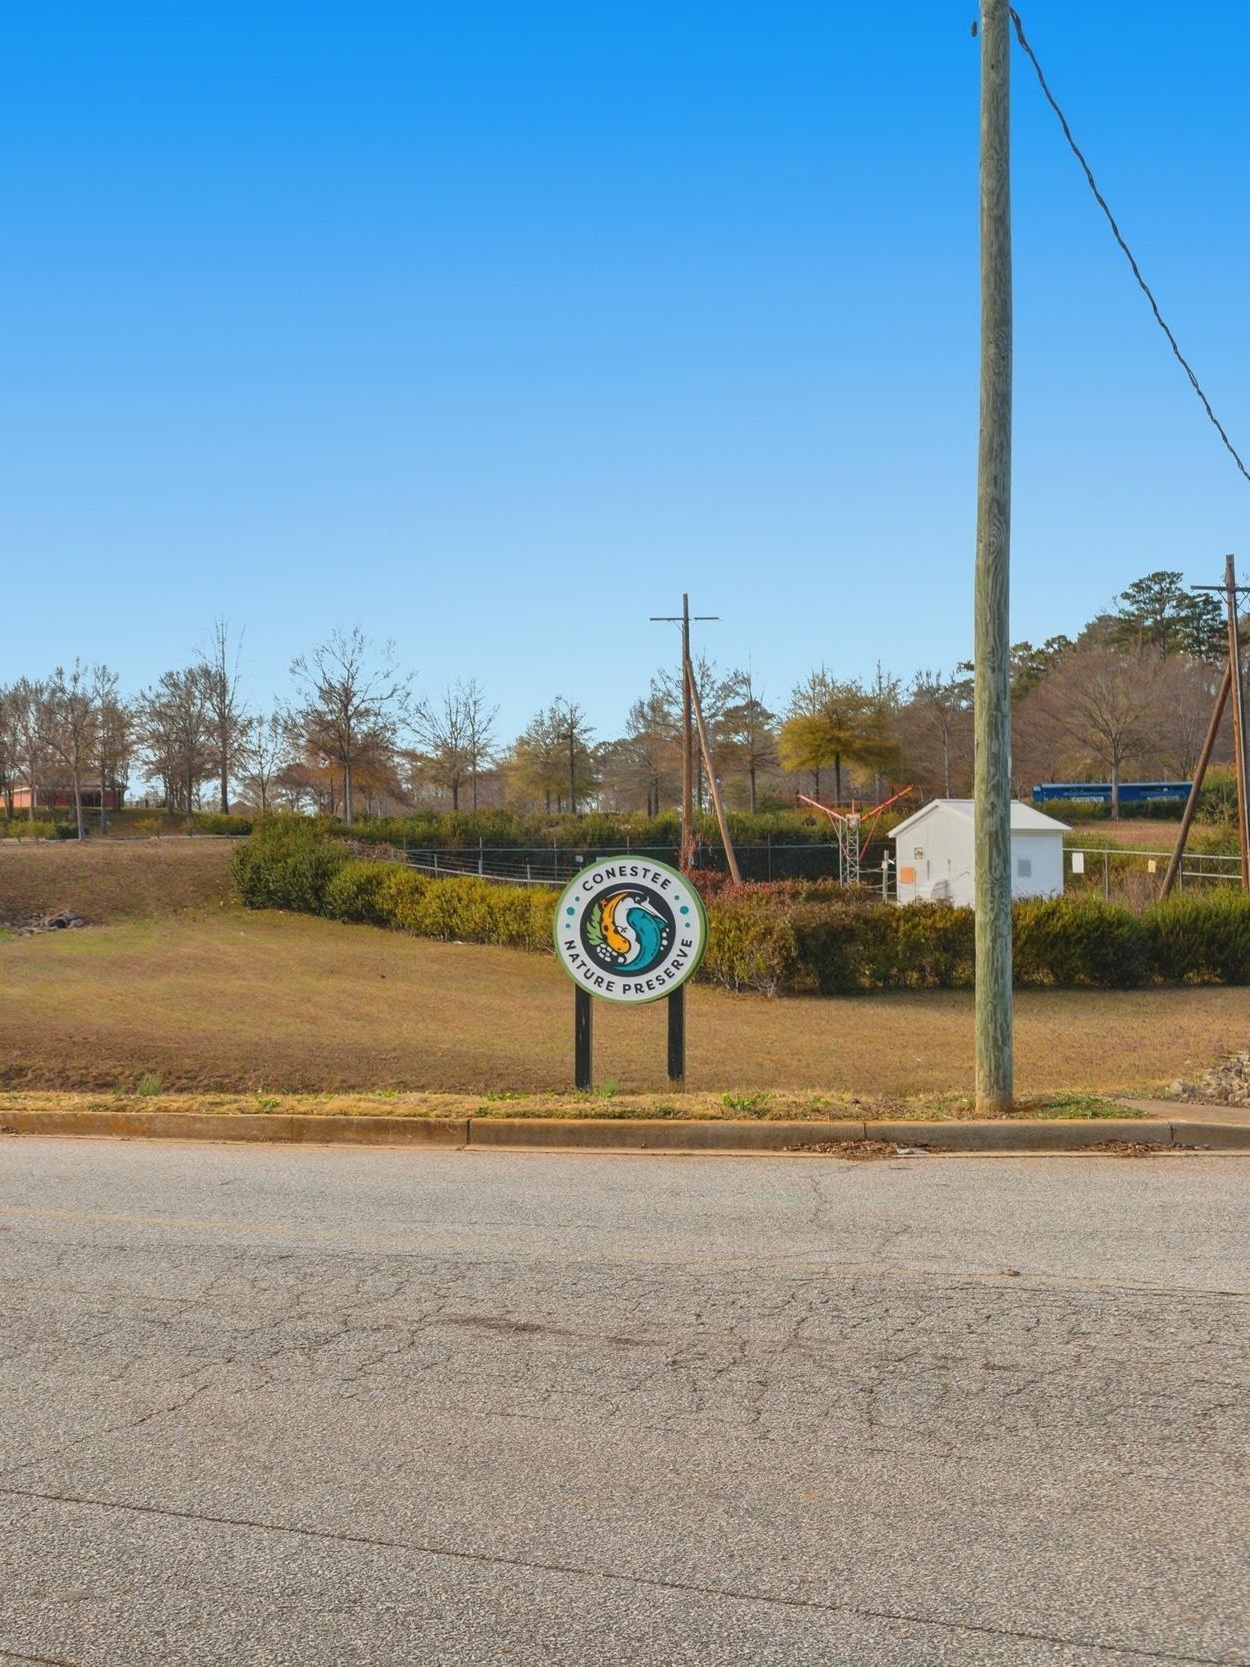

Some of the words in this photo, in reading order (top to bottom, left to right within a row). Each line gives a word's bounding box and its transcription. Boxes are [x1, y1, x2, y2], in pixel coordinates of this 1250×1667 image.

[582, 865, 671, 892] CONESTEE
[564, 939, 615, 992] NATURE
[622, 938, 693, 995] PRESERVE
